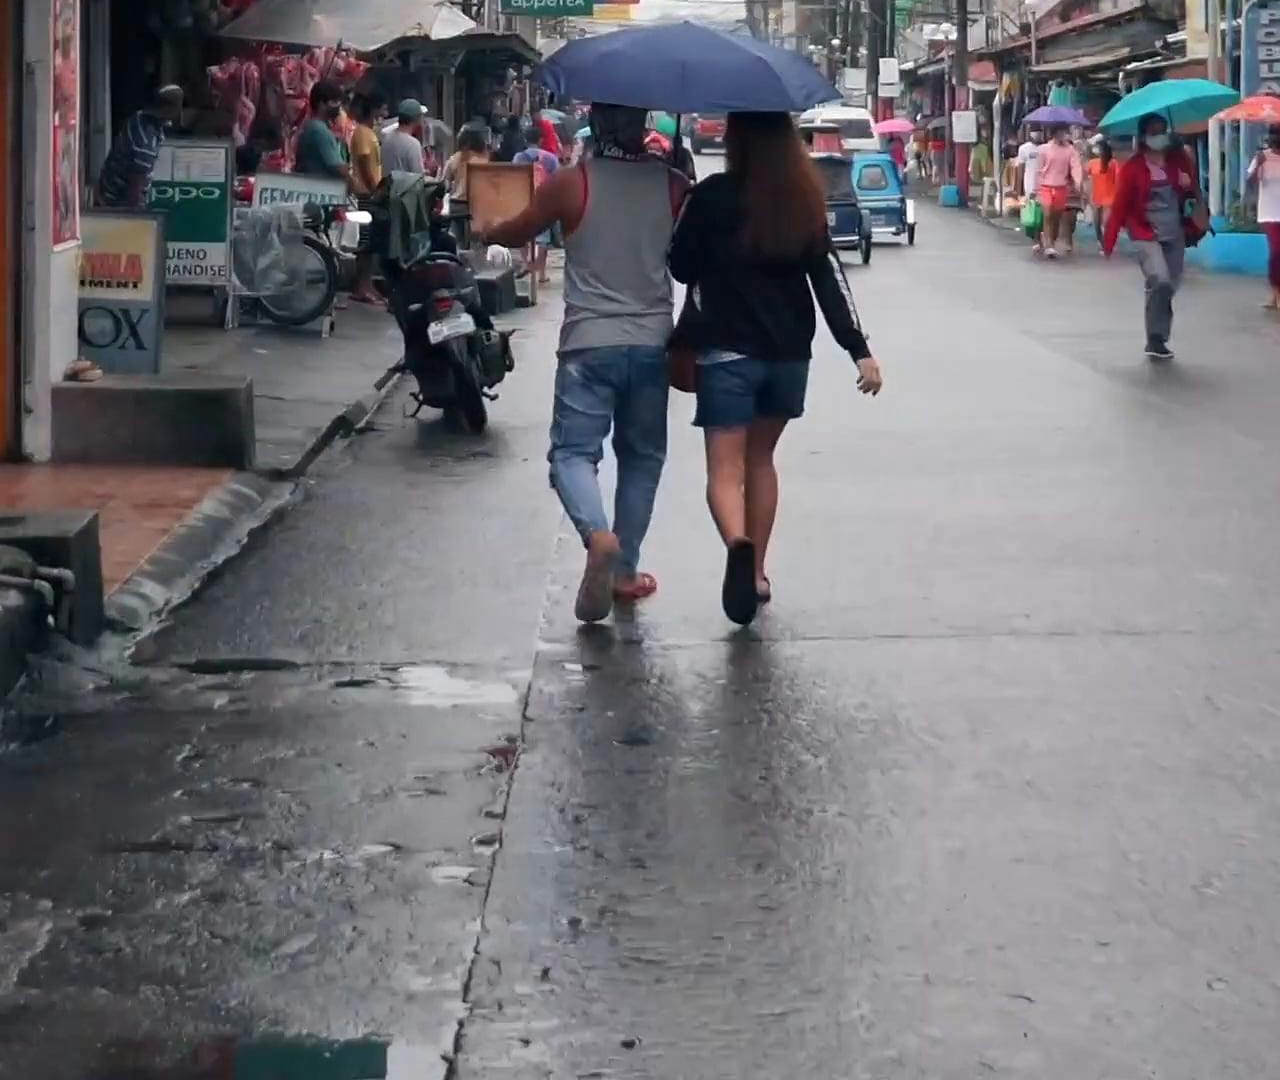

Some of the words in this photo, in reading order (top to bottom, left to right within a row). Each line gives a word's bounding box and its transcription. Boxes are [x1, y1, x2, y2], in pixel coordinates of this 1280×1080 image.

[151, 185, 221, 203] ppo
[165, 248, 207, 261] UENO
[78, 305, 150, 351] OX
